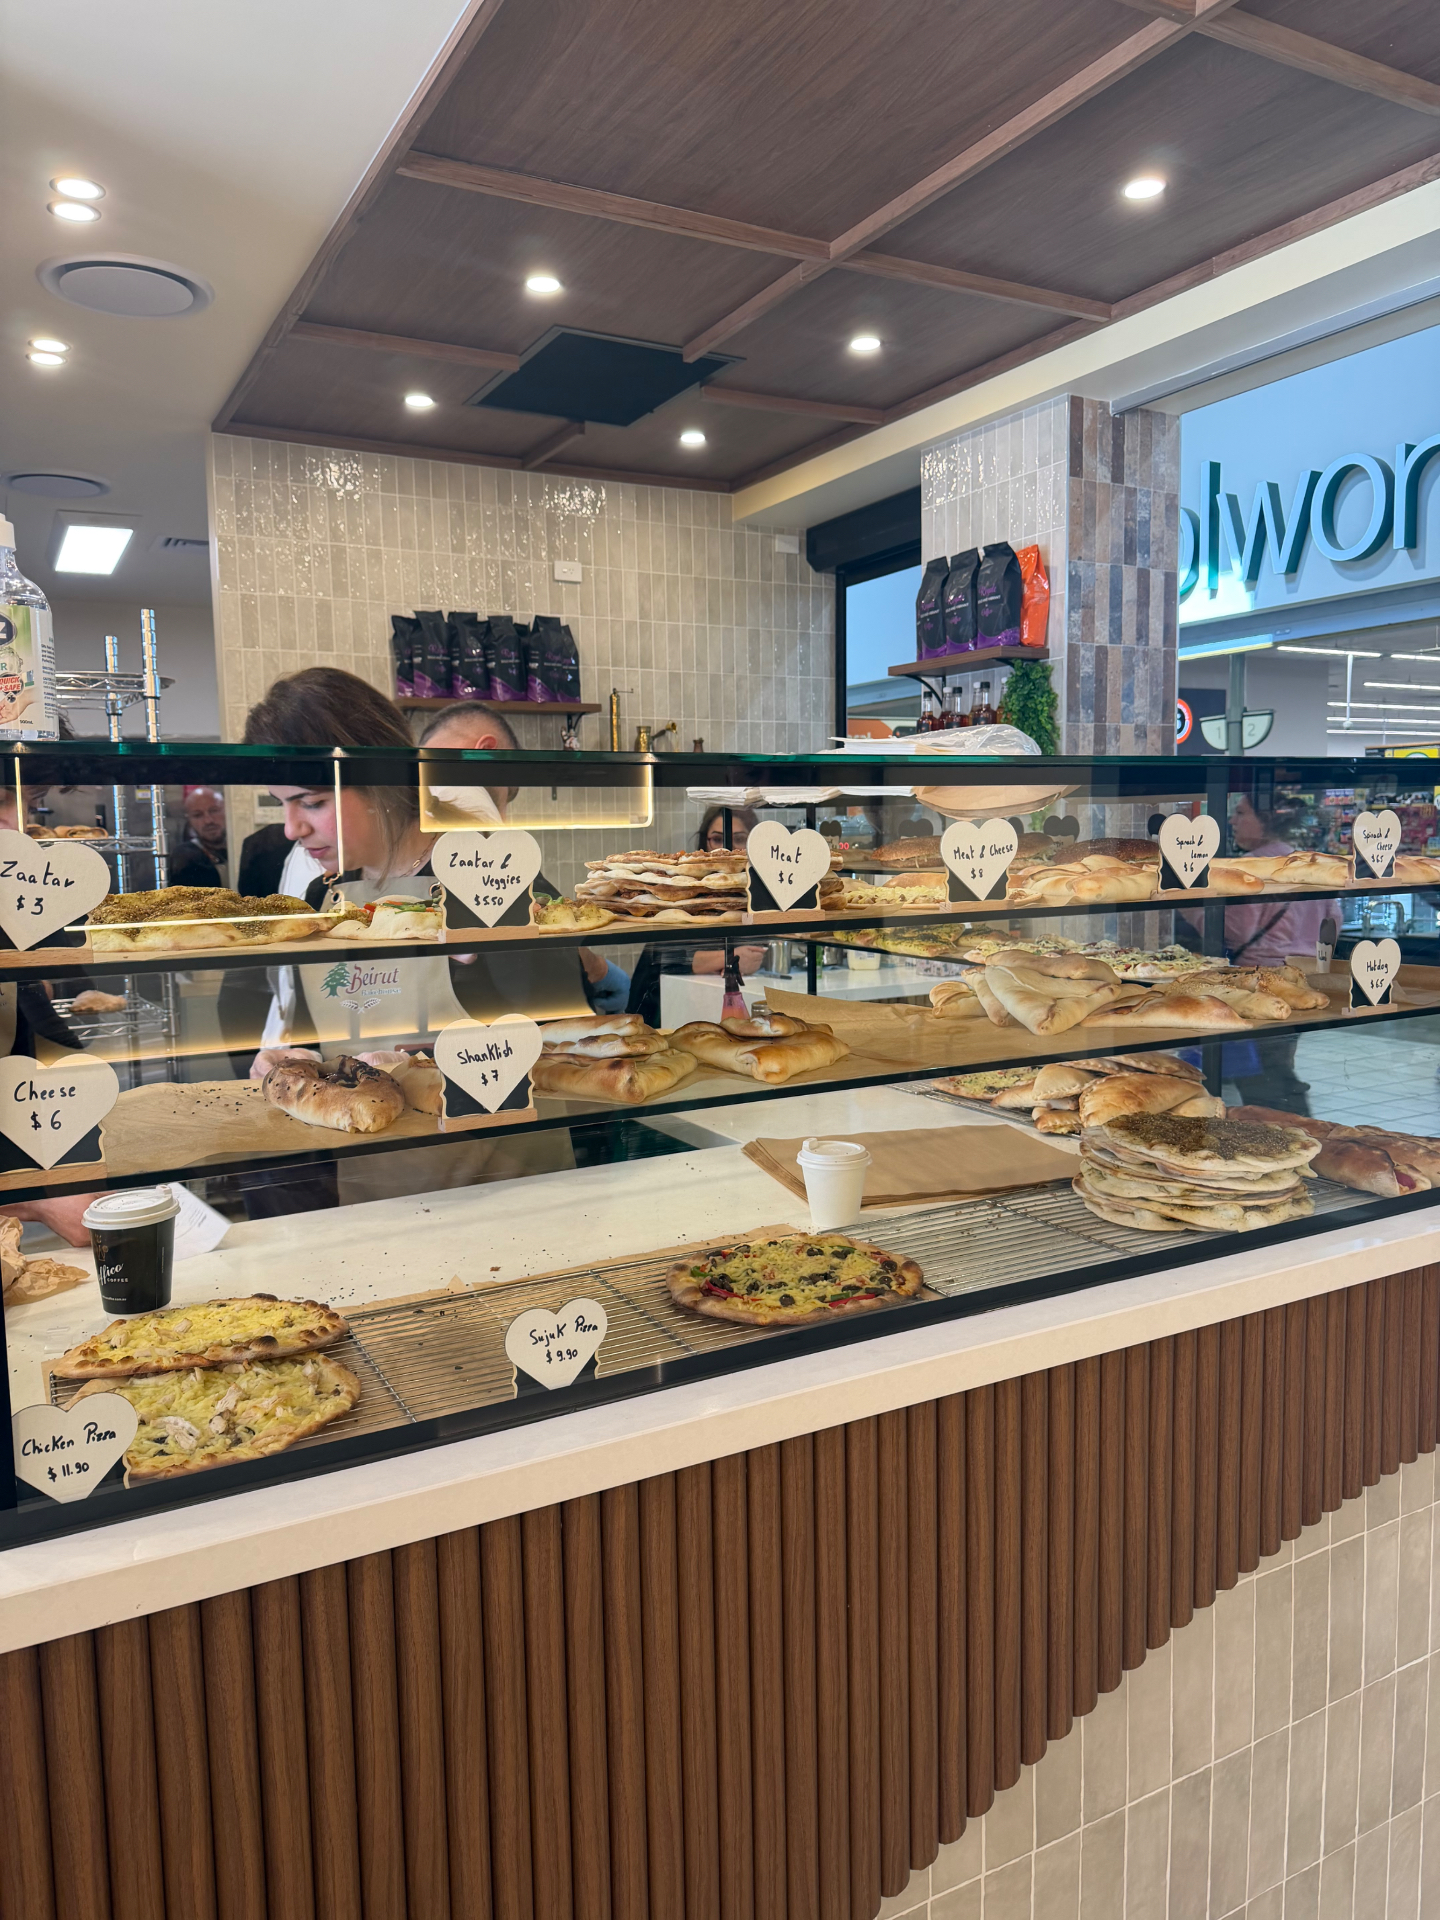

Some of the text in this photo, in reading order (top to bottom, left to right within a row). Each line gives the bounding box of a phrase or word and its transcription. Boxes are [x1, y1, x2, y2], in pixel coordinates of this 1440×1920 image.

[1247, 722, 1256, 737] 2
[770, 844, 802, 863] Meat
[953, 844, 975, 860] Meat
[989, 843, 1013, 857] Cheese
[1376, 841, 1393, 851] Cheese
[449, 850, 494, 868] Zaatar
[0, 860, 75, 887] Zaatar
[482, 875, 521, 890] Veggies
[345, 963, 400, 994] Beirut
[13, 1080, 77, 1103] Cheese
[574, 1314, 598, 1333] Pizza
[83, 1421, 117, 1445] Pizza
